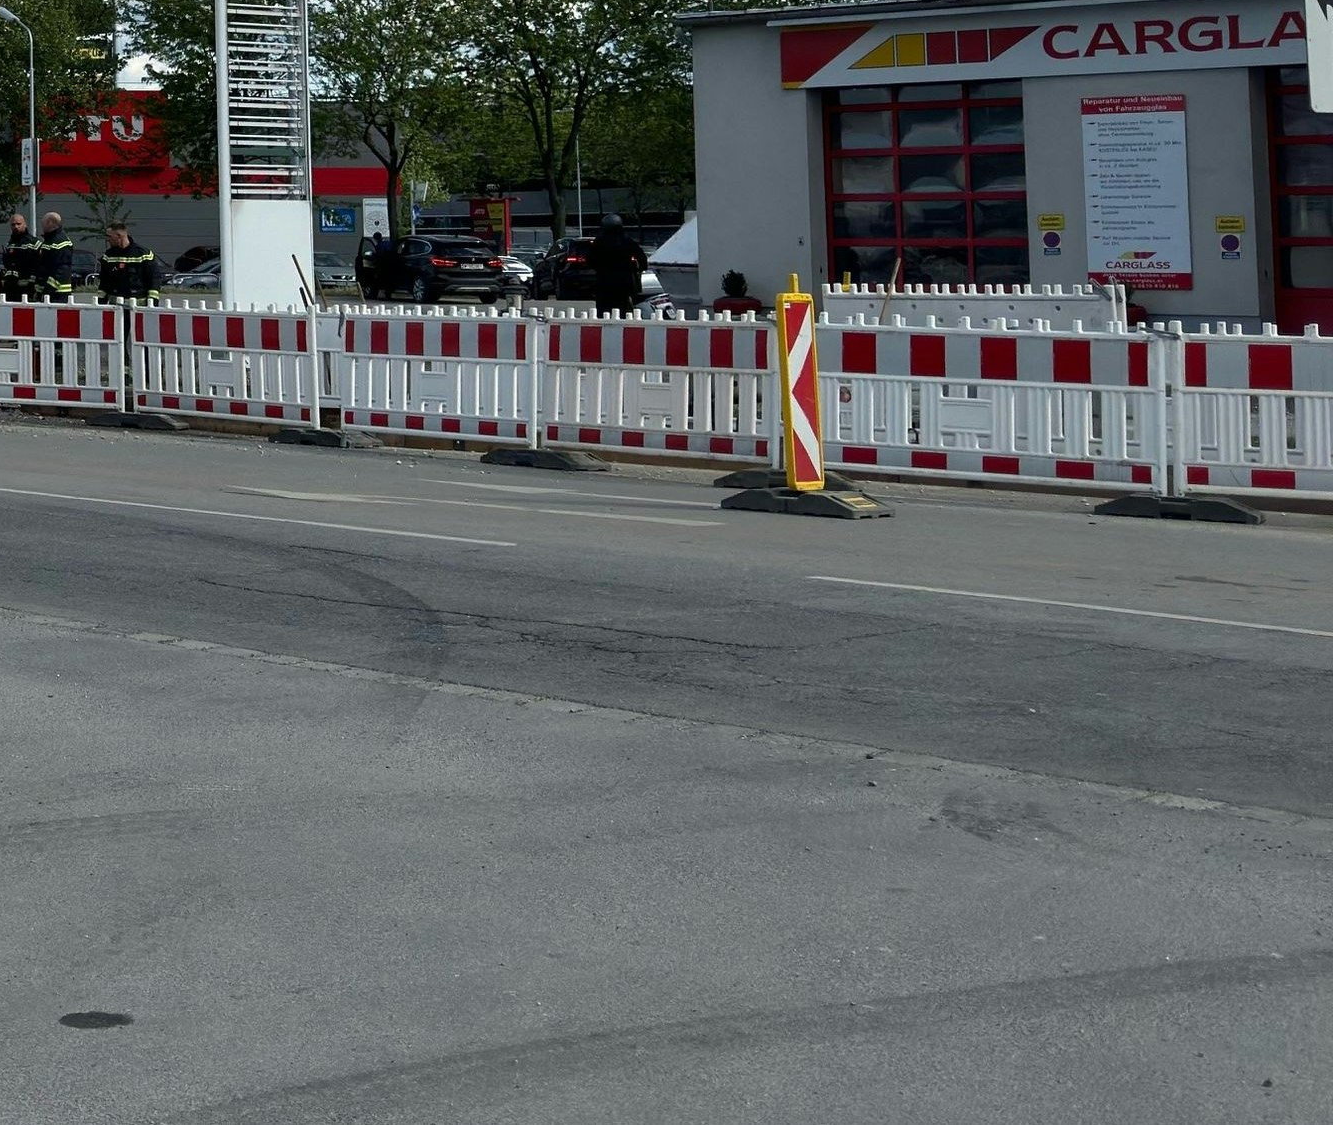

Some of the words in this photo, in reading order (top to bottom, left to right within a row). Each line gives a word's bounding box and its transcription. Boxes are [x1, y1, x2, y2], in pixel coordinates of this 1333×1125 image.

[1083, 97, 1121, 106] Reparatur
[1123, 96, 1138, 104] und
[1105, 261, 1171, 270] CARGLASS
